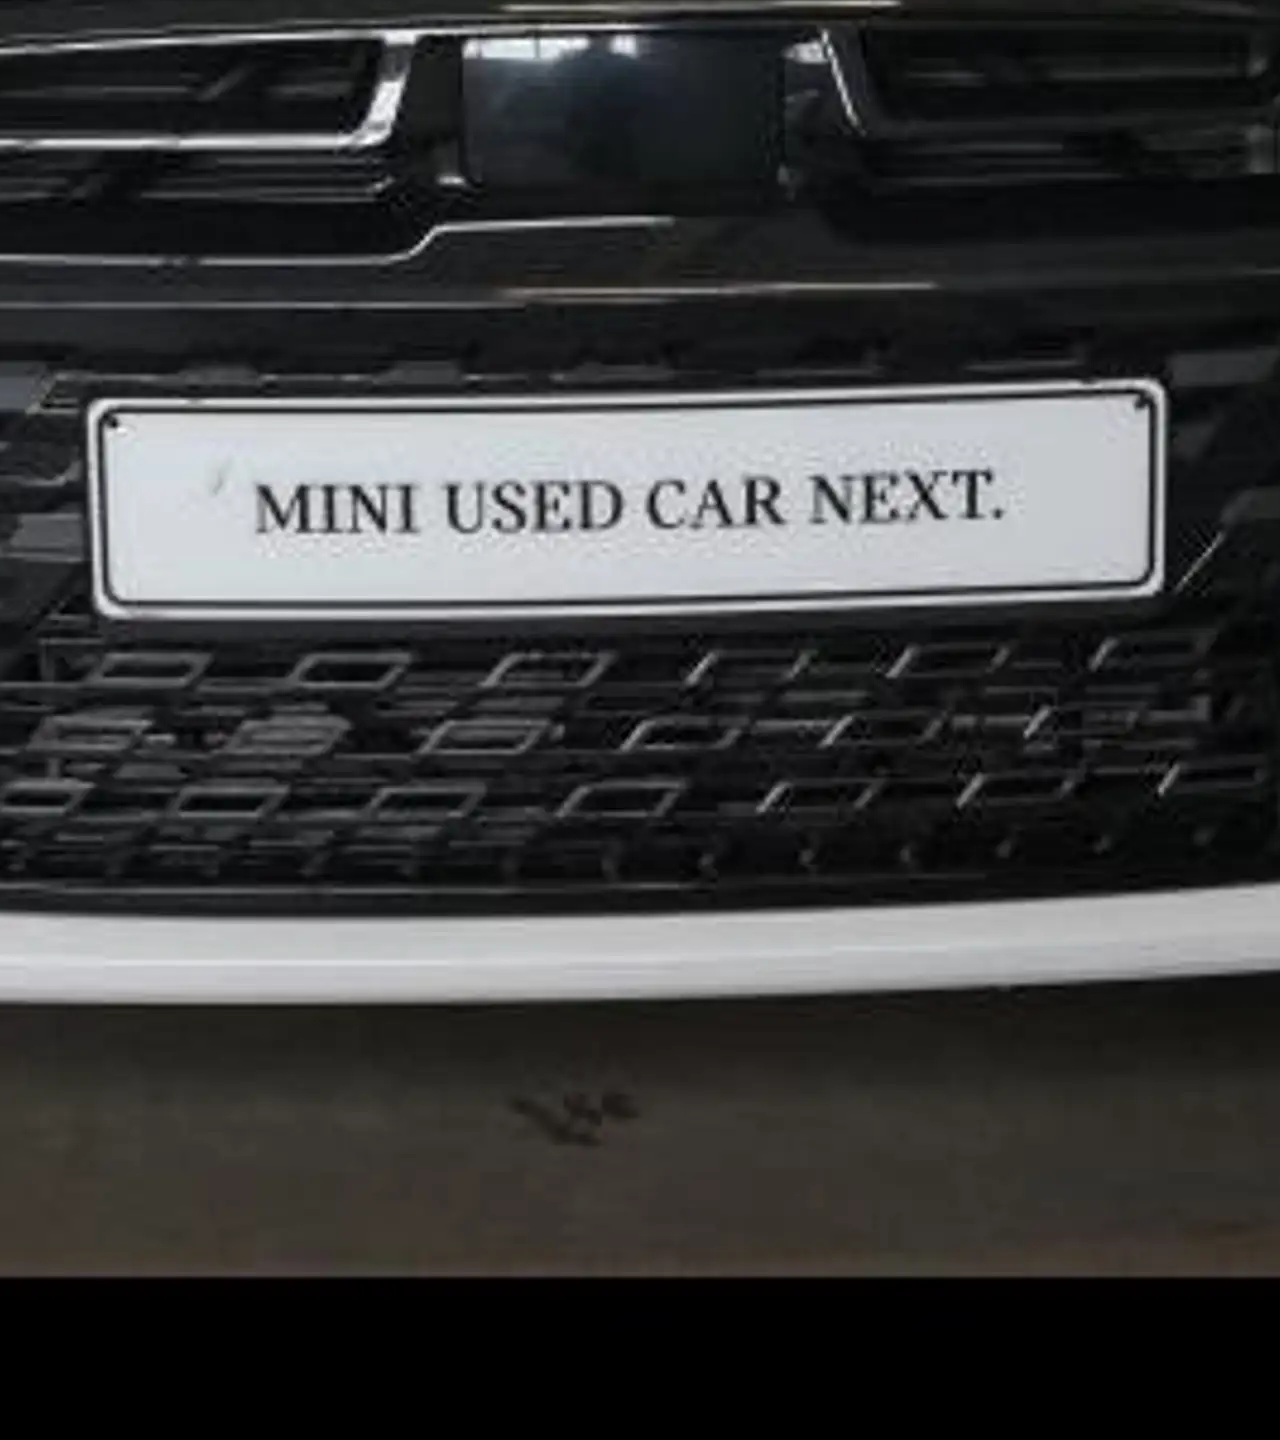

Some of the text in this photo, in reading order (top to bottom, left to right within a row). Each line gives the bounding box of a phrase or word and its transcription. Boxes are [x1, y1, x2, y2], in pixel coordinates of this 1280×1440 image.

[257, 469, 1003, 534] MINI USED CAR NEXT.
